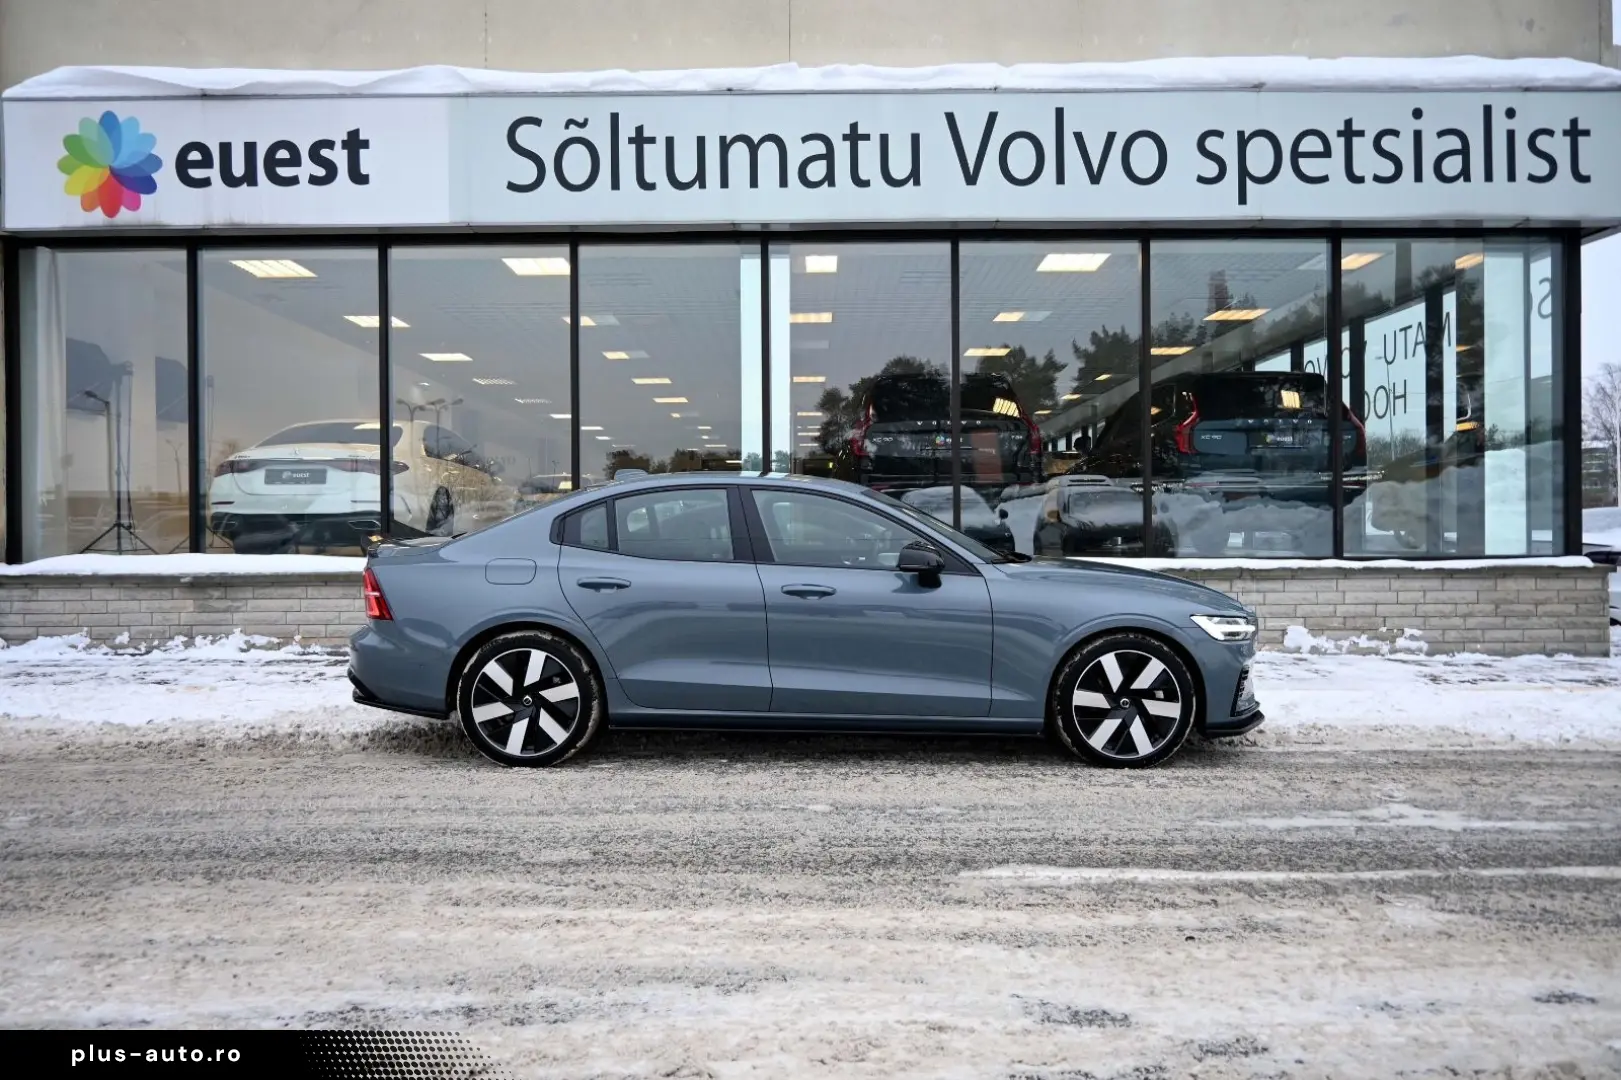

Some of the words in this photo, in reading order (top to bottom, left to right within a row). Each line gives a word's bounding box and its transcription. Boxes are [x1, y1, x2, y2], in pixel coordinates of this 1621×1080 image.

[175, 129, 369, 188] euest
[507, 113, 920, 192] Sõltumatu
[945, 107, 1167, 186] Volvo
[1197, 104, 1591, 205] spetsialist
